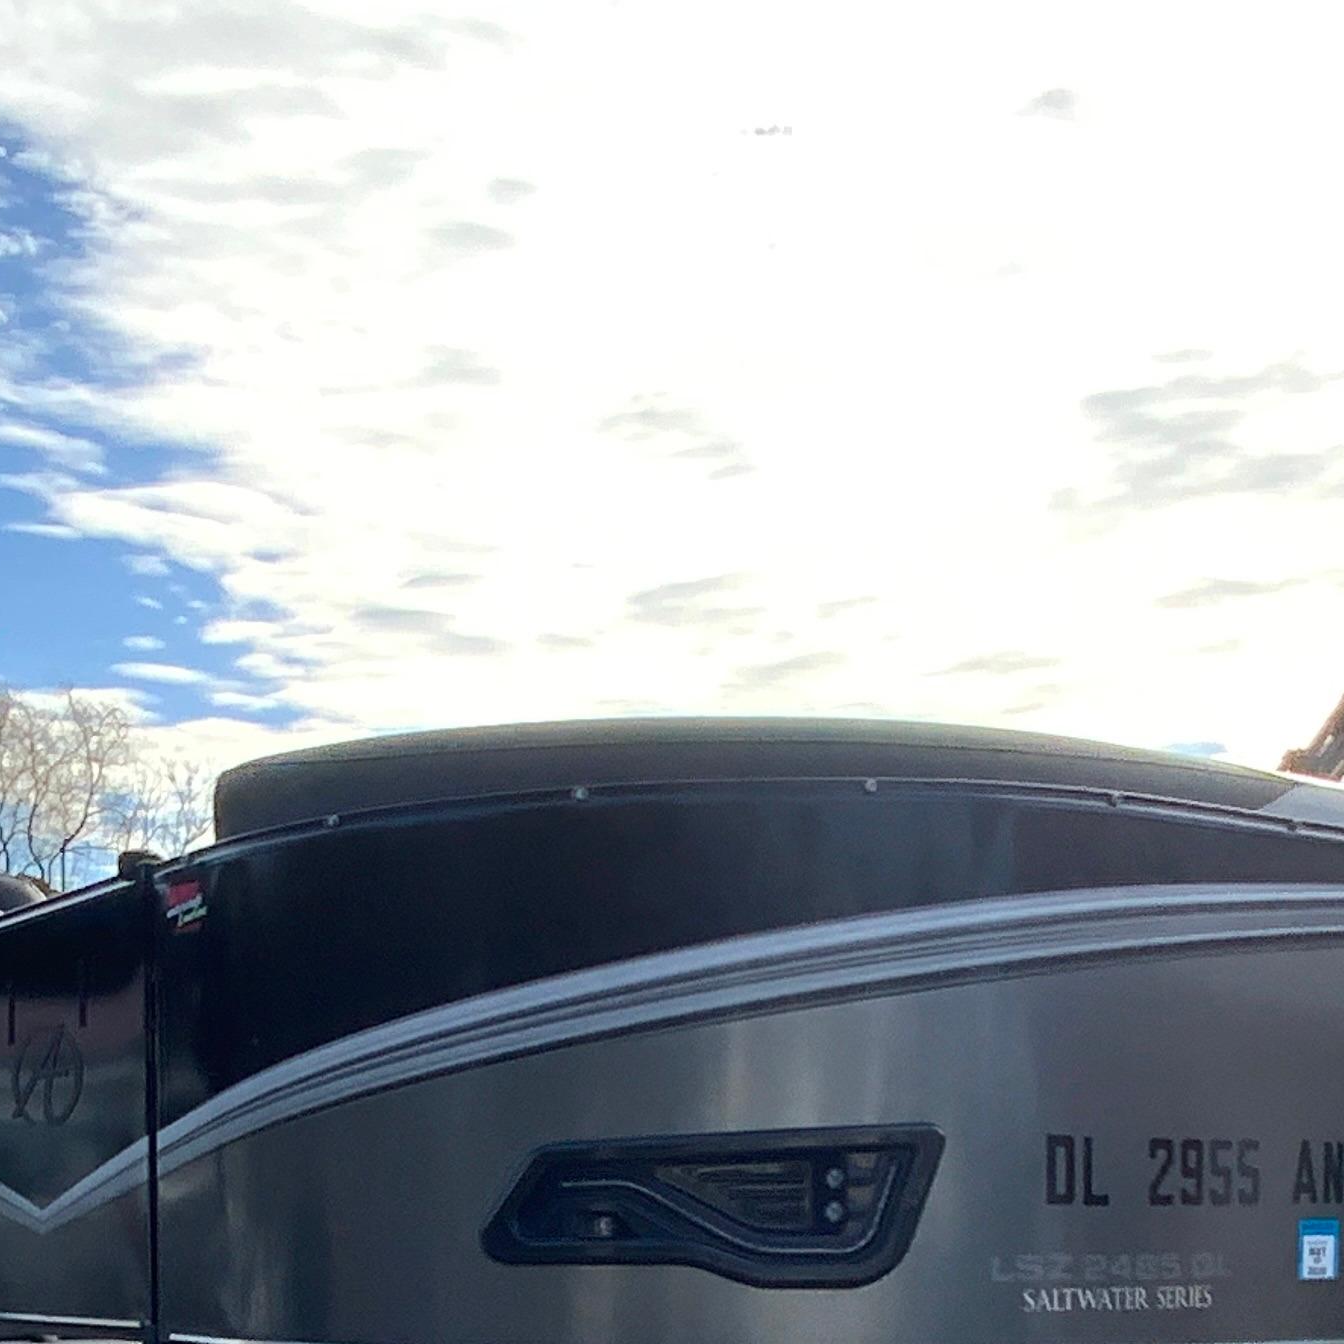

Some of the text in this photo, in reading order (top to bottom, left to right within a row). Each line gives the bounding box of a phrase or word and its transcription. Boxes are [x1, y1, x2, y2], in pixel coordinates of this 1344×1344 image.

[1045, 1134, 1344, 1206] DL 2955 AN
[1022, 1283, 1213, 1313] SALTWATER SERIES
